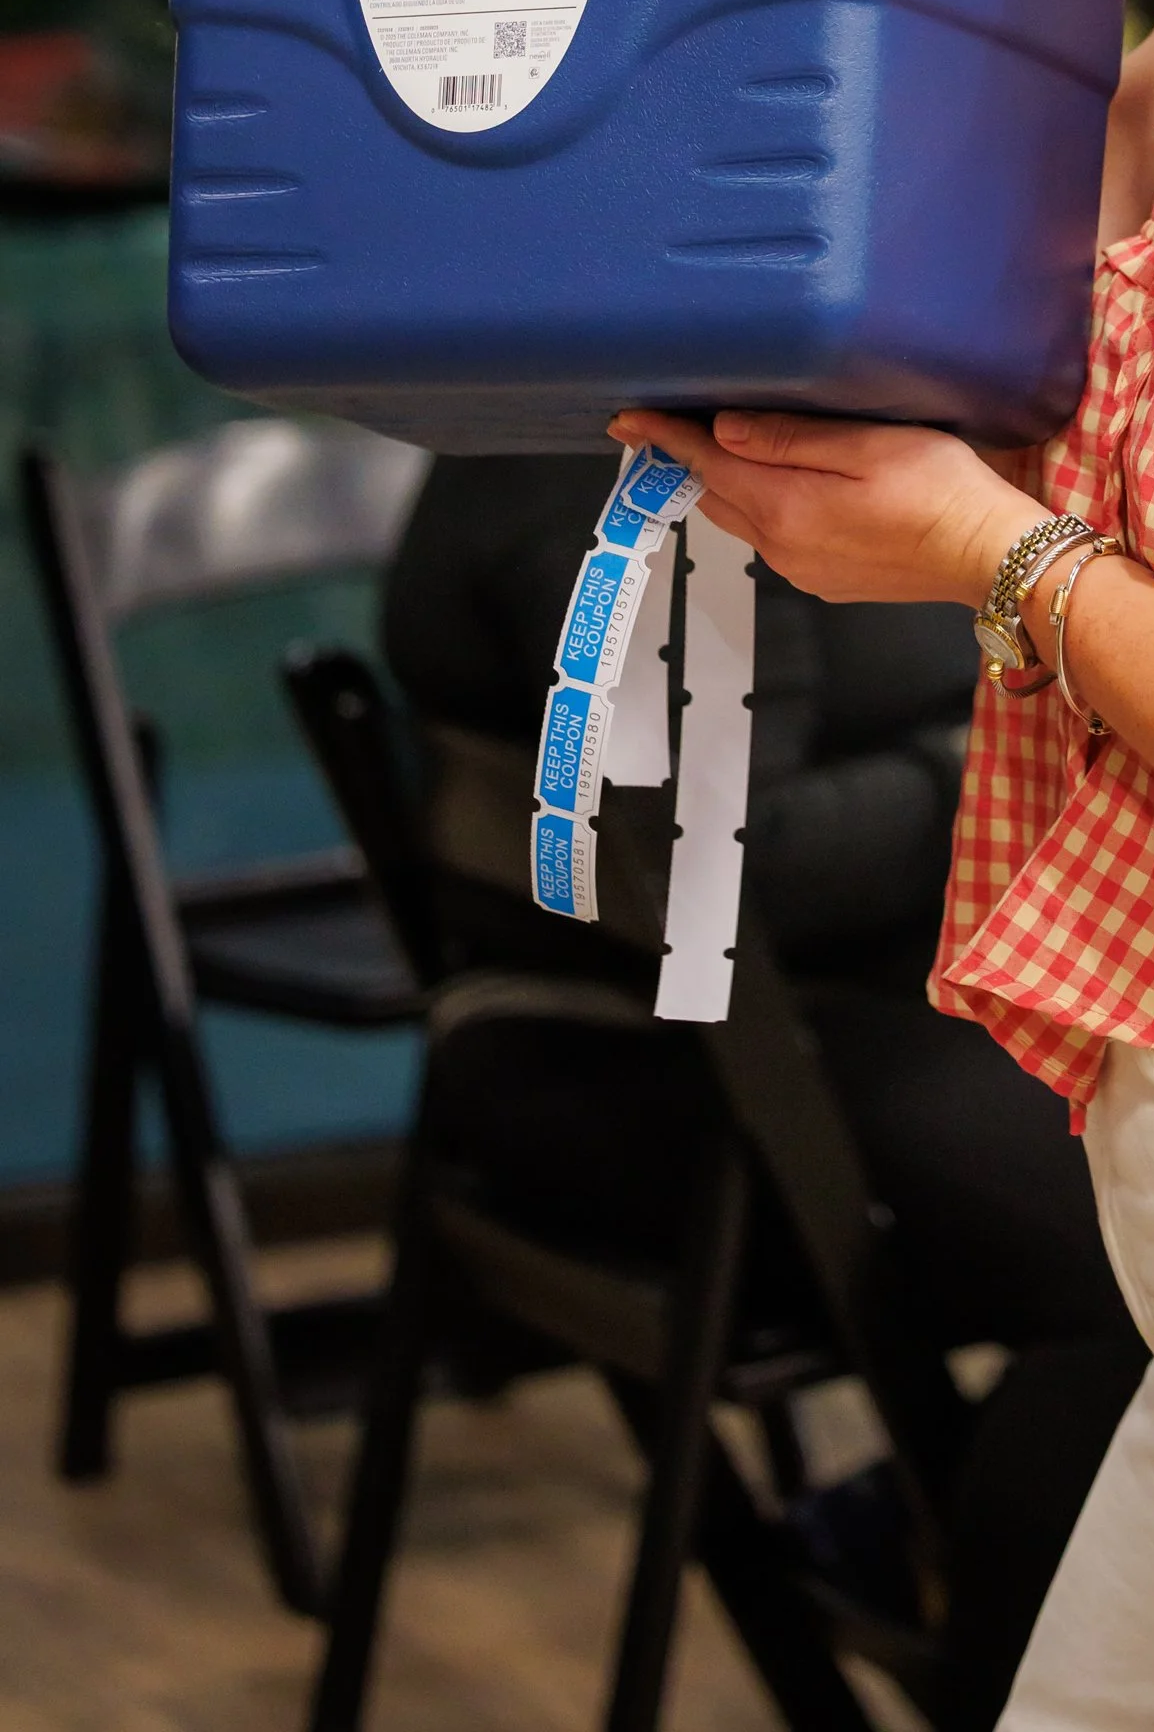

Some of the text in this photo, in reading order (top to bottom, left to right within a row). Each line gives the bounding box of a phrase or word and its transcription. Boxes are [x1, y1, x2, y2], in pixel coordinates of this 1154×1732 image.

[445, 105, 467, 113] 76501
[566, 567, 604, 661] KEEP THIS
[583, 578, 617, 658] COUPON
[600, 576, 635, 667] 19570579
[544, 703, 569, 791] KEEP THIS
[560, 714, 583, 789] COUPON
[578, 712, 600, 798] 19570580
[541, 827, 555, 899] KEEP THIS
[555, 837, 570, 898] COUPON
[573, 839, 585, 906] 19570581
